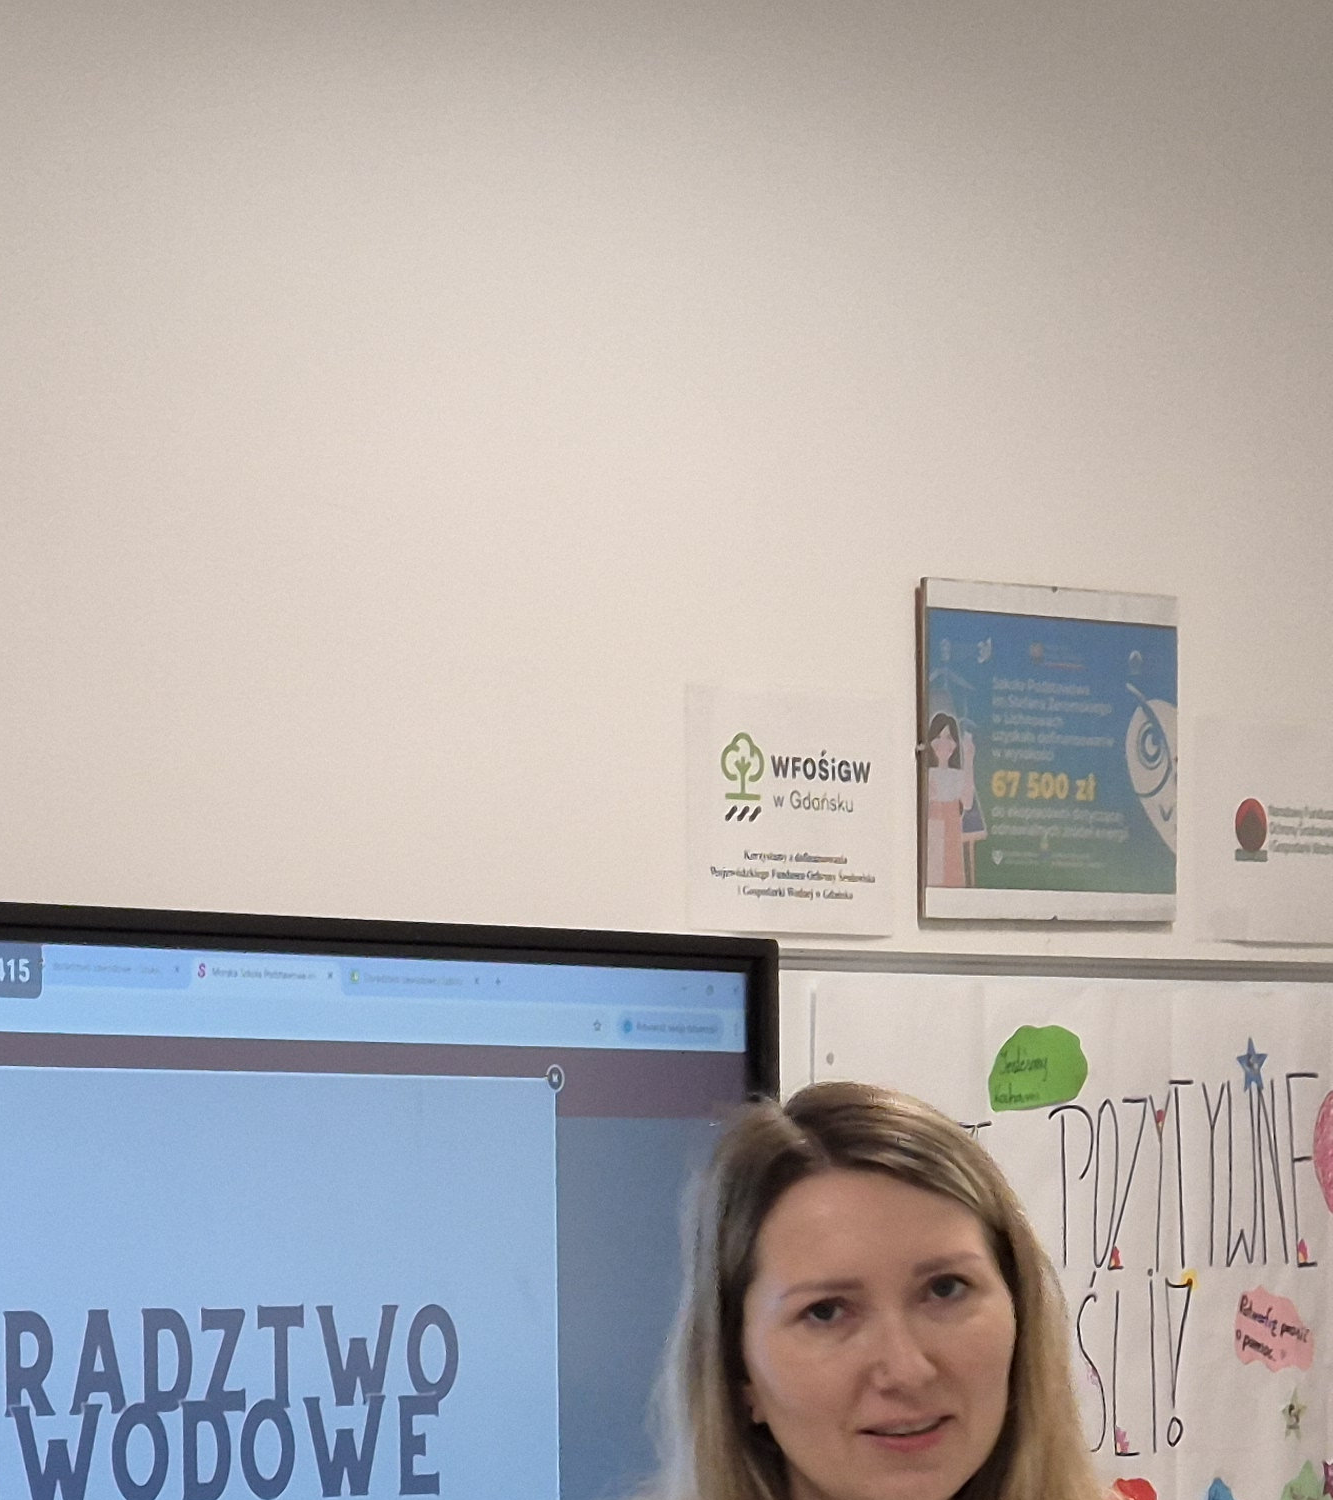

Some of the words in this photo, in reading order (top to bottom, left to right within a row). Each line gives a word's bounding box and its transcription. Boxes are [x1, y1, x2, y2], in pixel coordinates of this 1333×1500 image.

[770, 750, 871, 784] WFOŚiGW
[991, 771, 1020, 798] 67
[1027, 773, 1068, 799] 500
[773, 795, 784, 808] w
[790, 790, 854, 813] Gdańsku
[1076, 1269, 1194, 1456] ŚLI!
